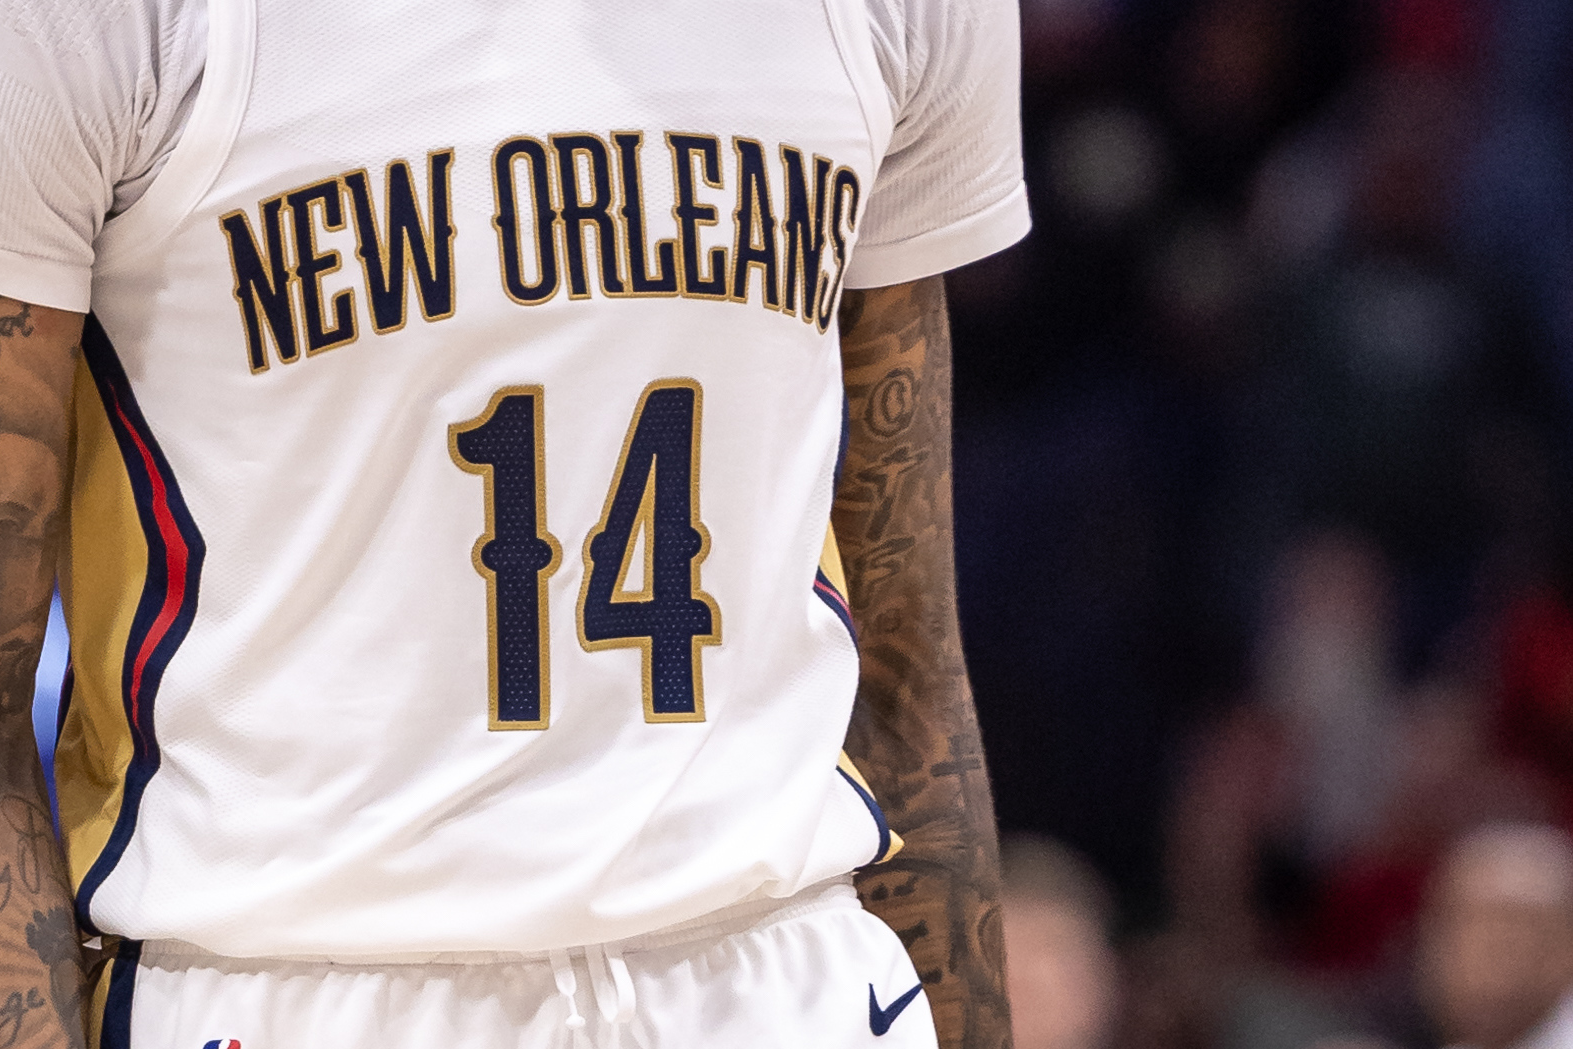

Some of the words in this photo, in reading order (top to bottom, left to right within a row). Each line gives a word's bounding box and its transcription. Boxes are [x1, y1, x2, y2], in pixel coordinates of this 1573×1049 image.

[218, 147, 458, 375] NEW
[490, 130, 861, 335] ORLEANS
[447, 376, 723, 732] 14
